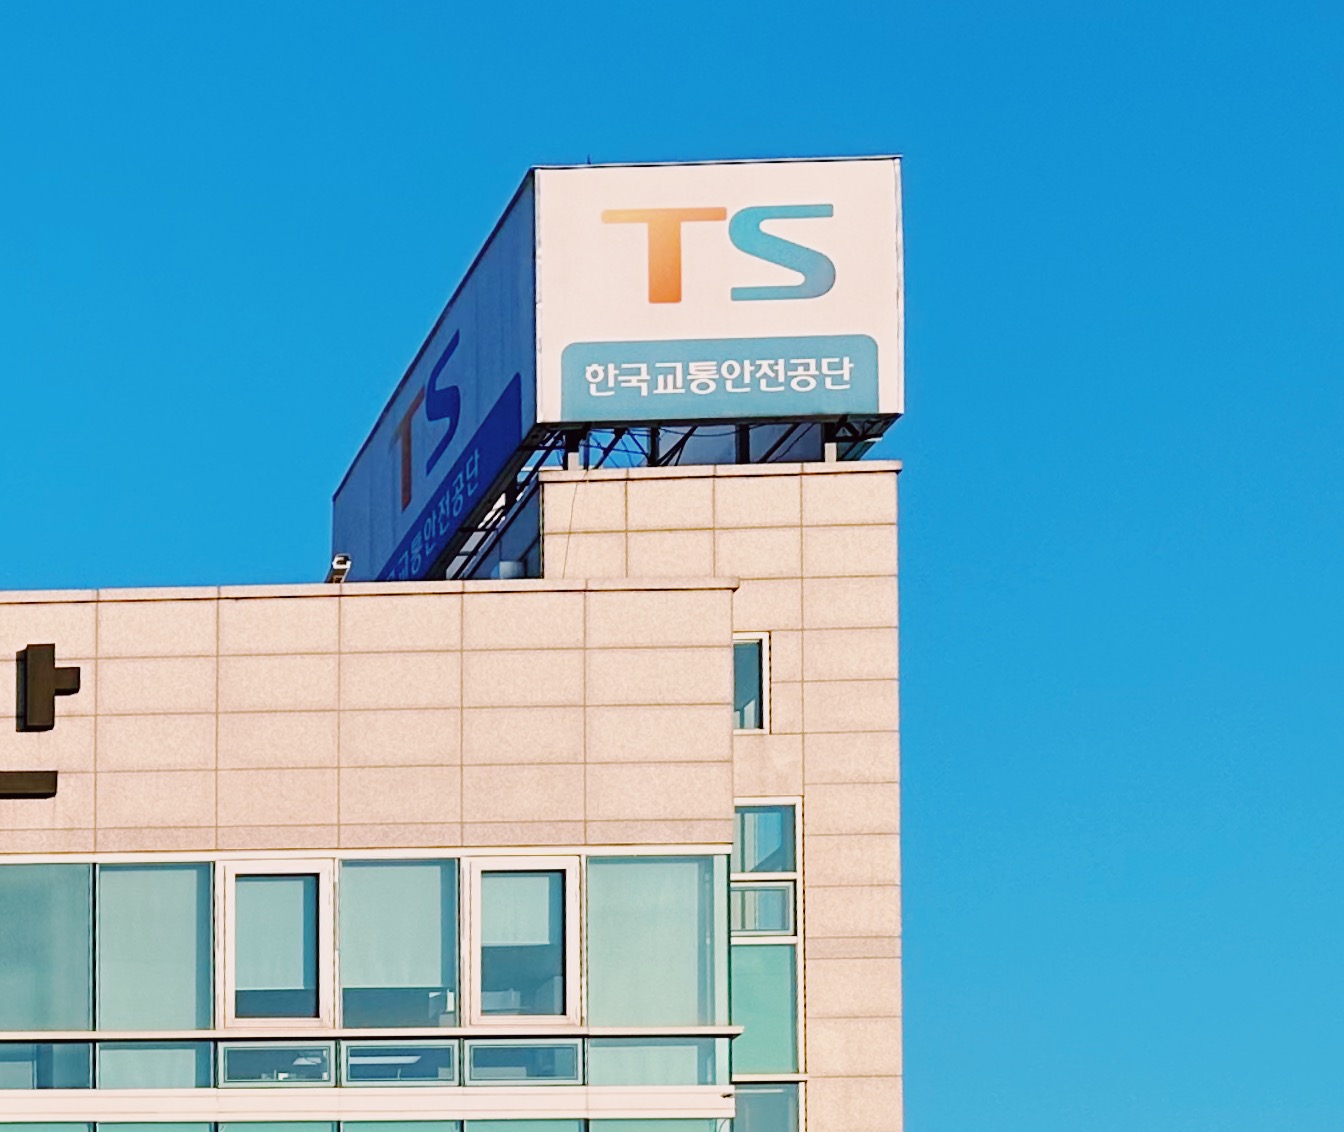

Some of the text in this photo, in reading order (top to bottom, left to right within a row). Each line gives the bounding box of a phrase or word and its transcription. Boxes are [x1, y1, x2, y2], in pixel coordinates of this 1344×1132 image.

[601, 203, 837, 304] TS
[389, 329, 461, 513] TS
[584, 355, 855, 396] 한국교통안전공단
